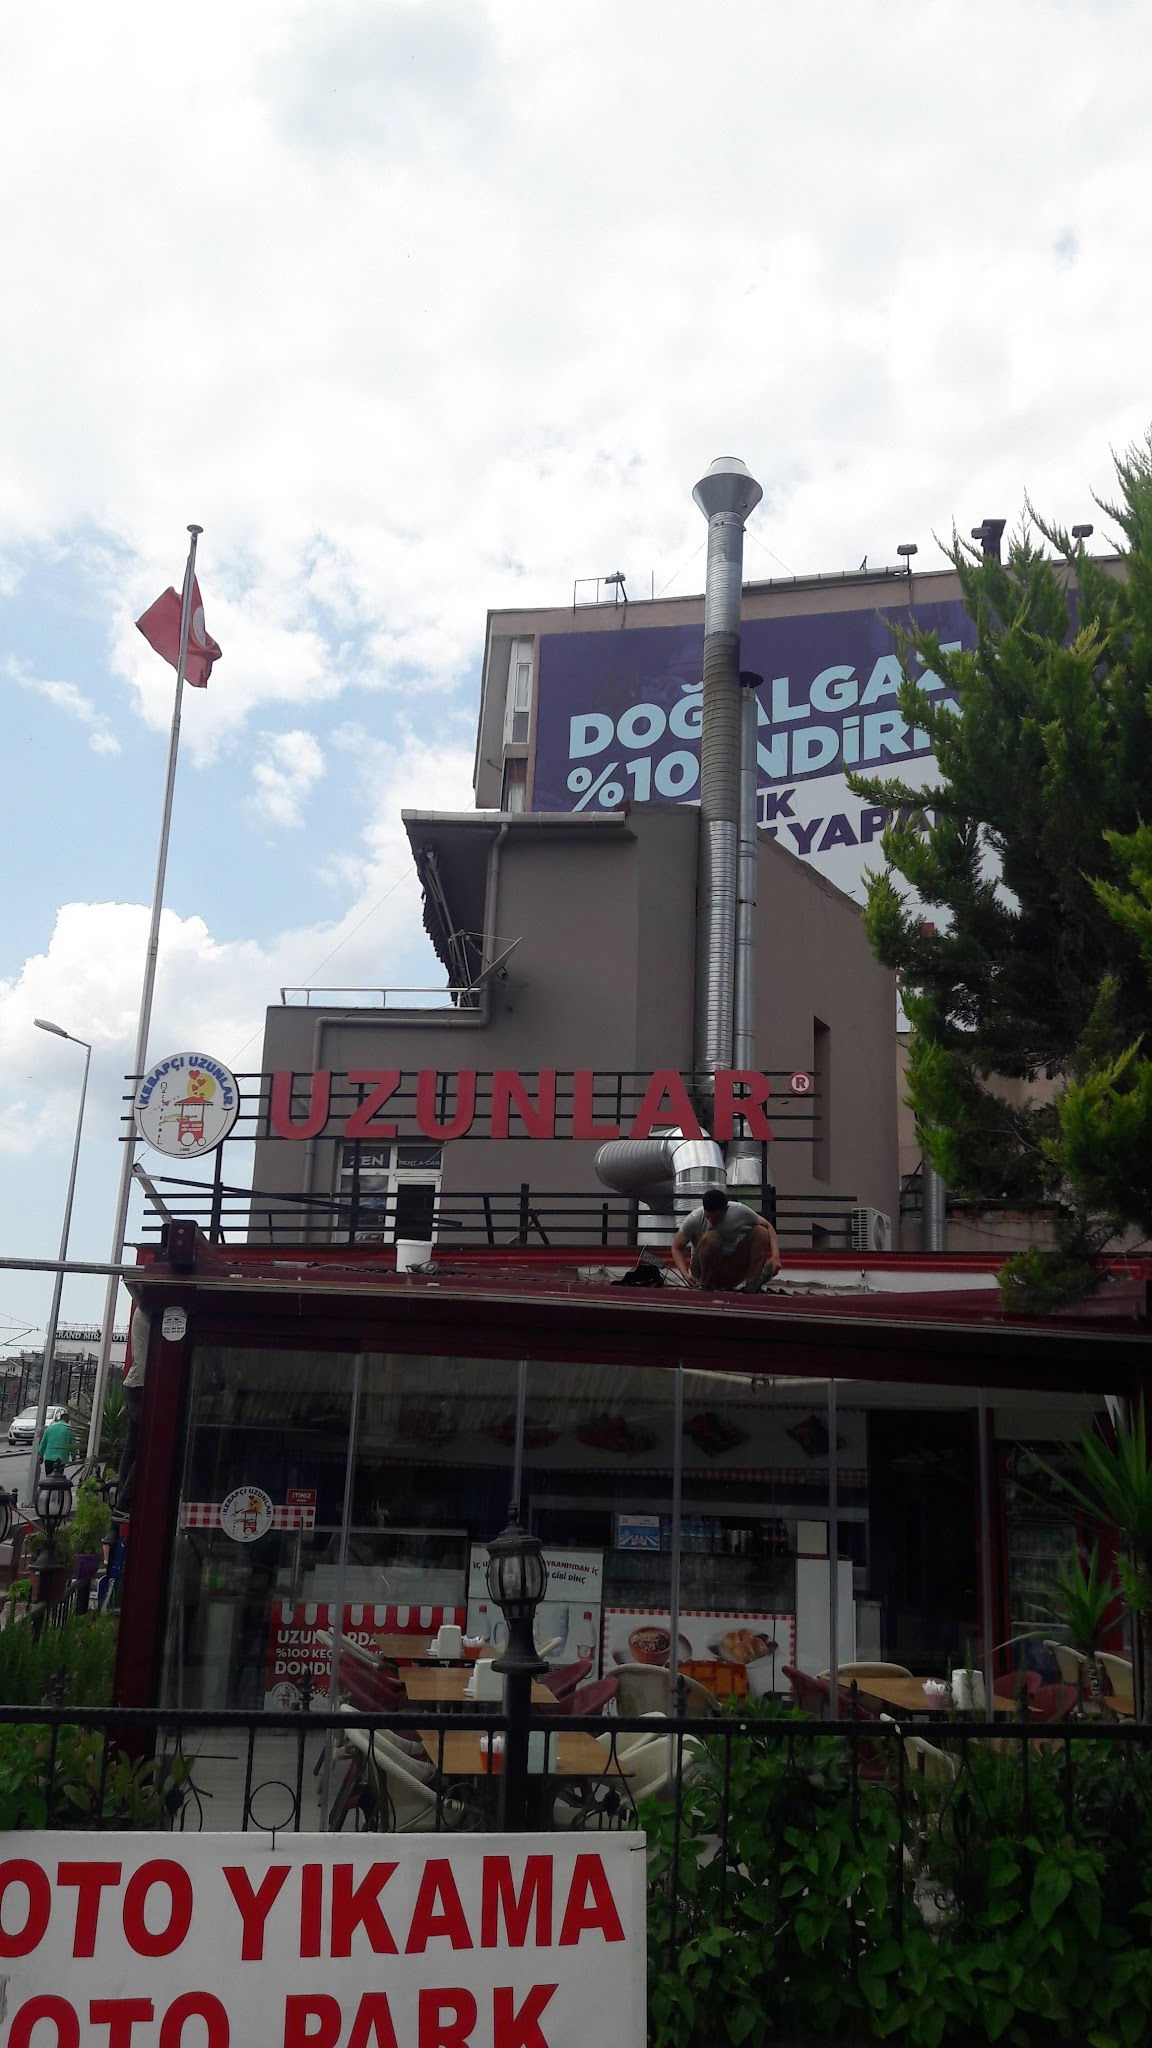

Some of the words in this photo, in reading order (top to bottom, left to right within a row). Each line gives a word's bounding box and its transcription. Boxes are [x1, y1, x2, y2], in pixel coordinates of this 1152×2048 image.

[566, 750, 700, 812] %10
[139, 1056, 184, 1105] KEBAPÇI
[188, 1056, 234, 1106] UZUNLAR
[271, 1070, 774, 1140] UZUNLAR
[275, 1647, 310, 1659] %100
[0, 1858, 193, 1958] OTO
[221, 1853, 626, 1961] YIKAMA
[8, 1992, 230, 2048] OTO
[283, 1983, 559, 2048] PARK
